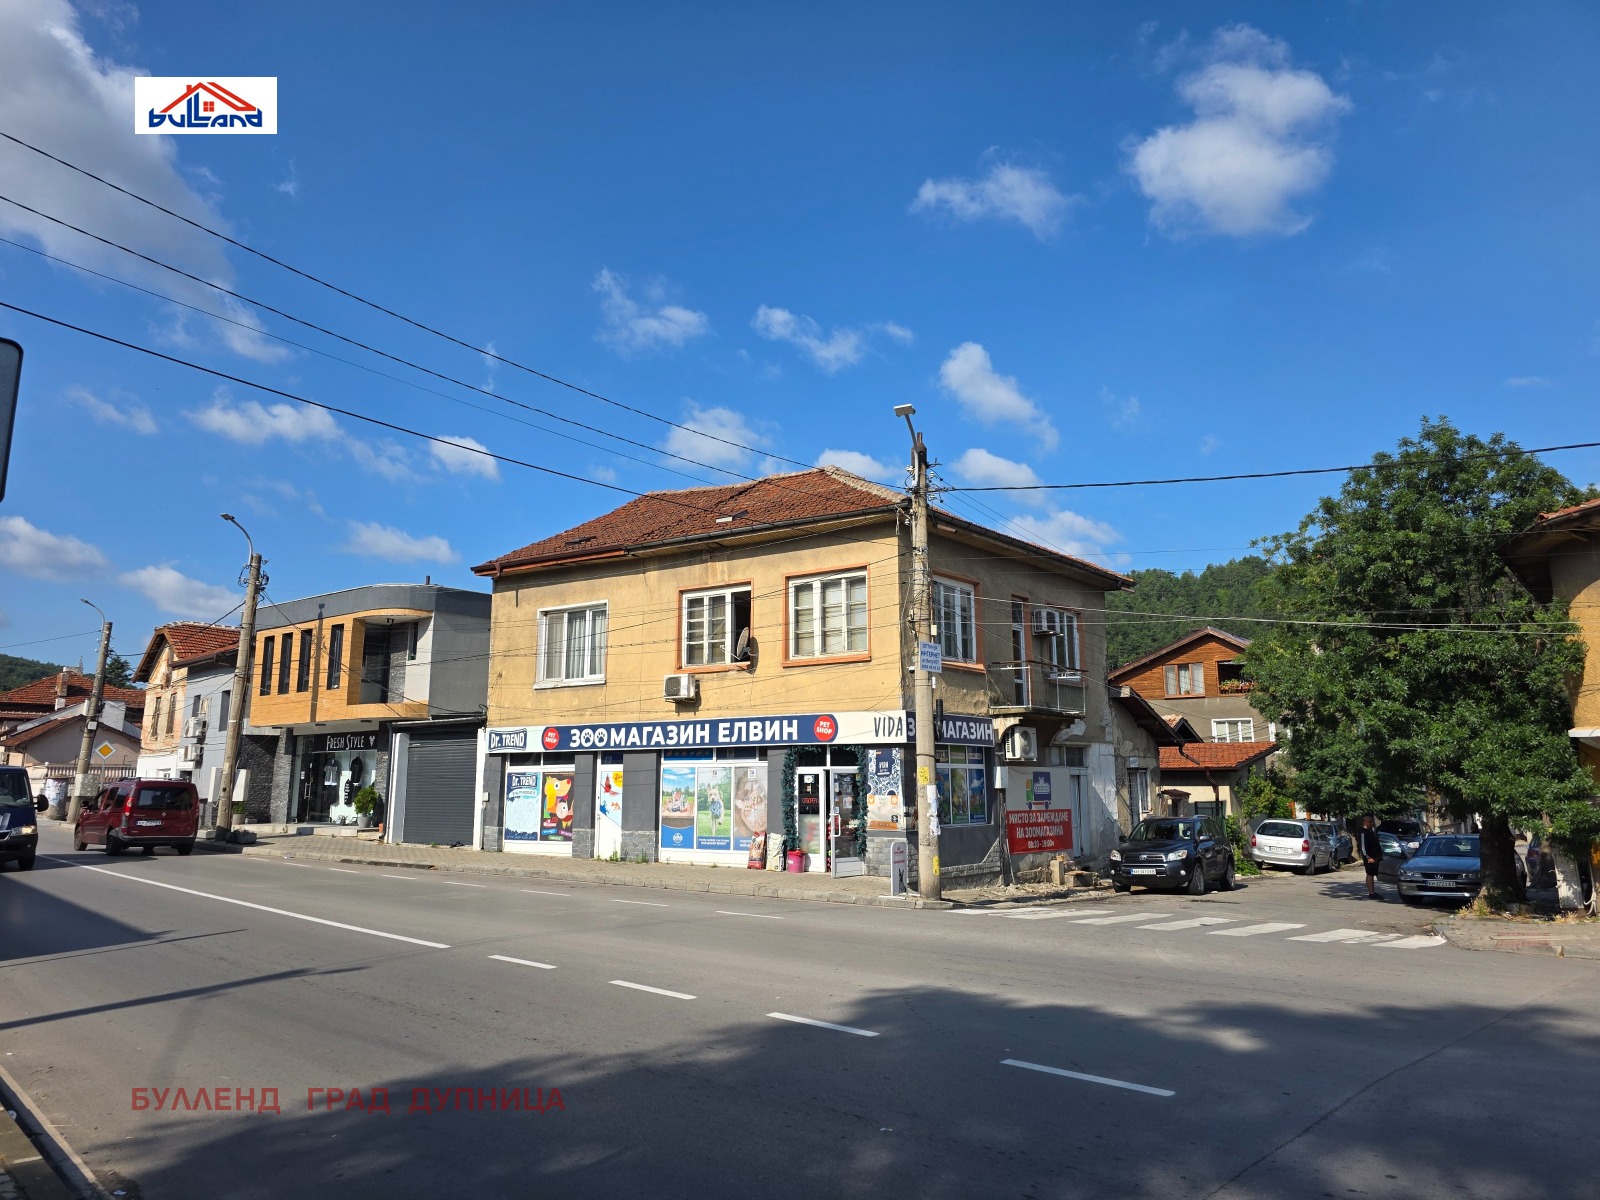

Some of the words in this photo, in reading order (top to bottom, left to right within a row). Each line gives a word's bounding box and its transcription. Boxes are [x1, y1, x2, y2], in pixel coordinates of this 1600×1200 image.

[718, 719, 798, 743] ЕЛВИН
[816, 726, 833, 735] SHOP
[873, 716, 903, 738] VIDA
[490, 733, 502, 748] Dr.
[501, 733, 526, 747] TREND
[545, 736, 558, 744] SHOP
[1009, 813, 1028, 825] МЯСТО
[1029, 812, 1037, 823] ЗА
[1037, 811, 1069, 825] ЗАРЕЖДАНЕ
[1016, 827, 1025, 839] НА
[1025, 825, 1064, 838] ЗООМАГАЗИНА
